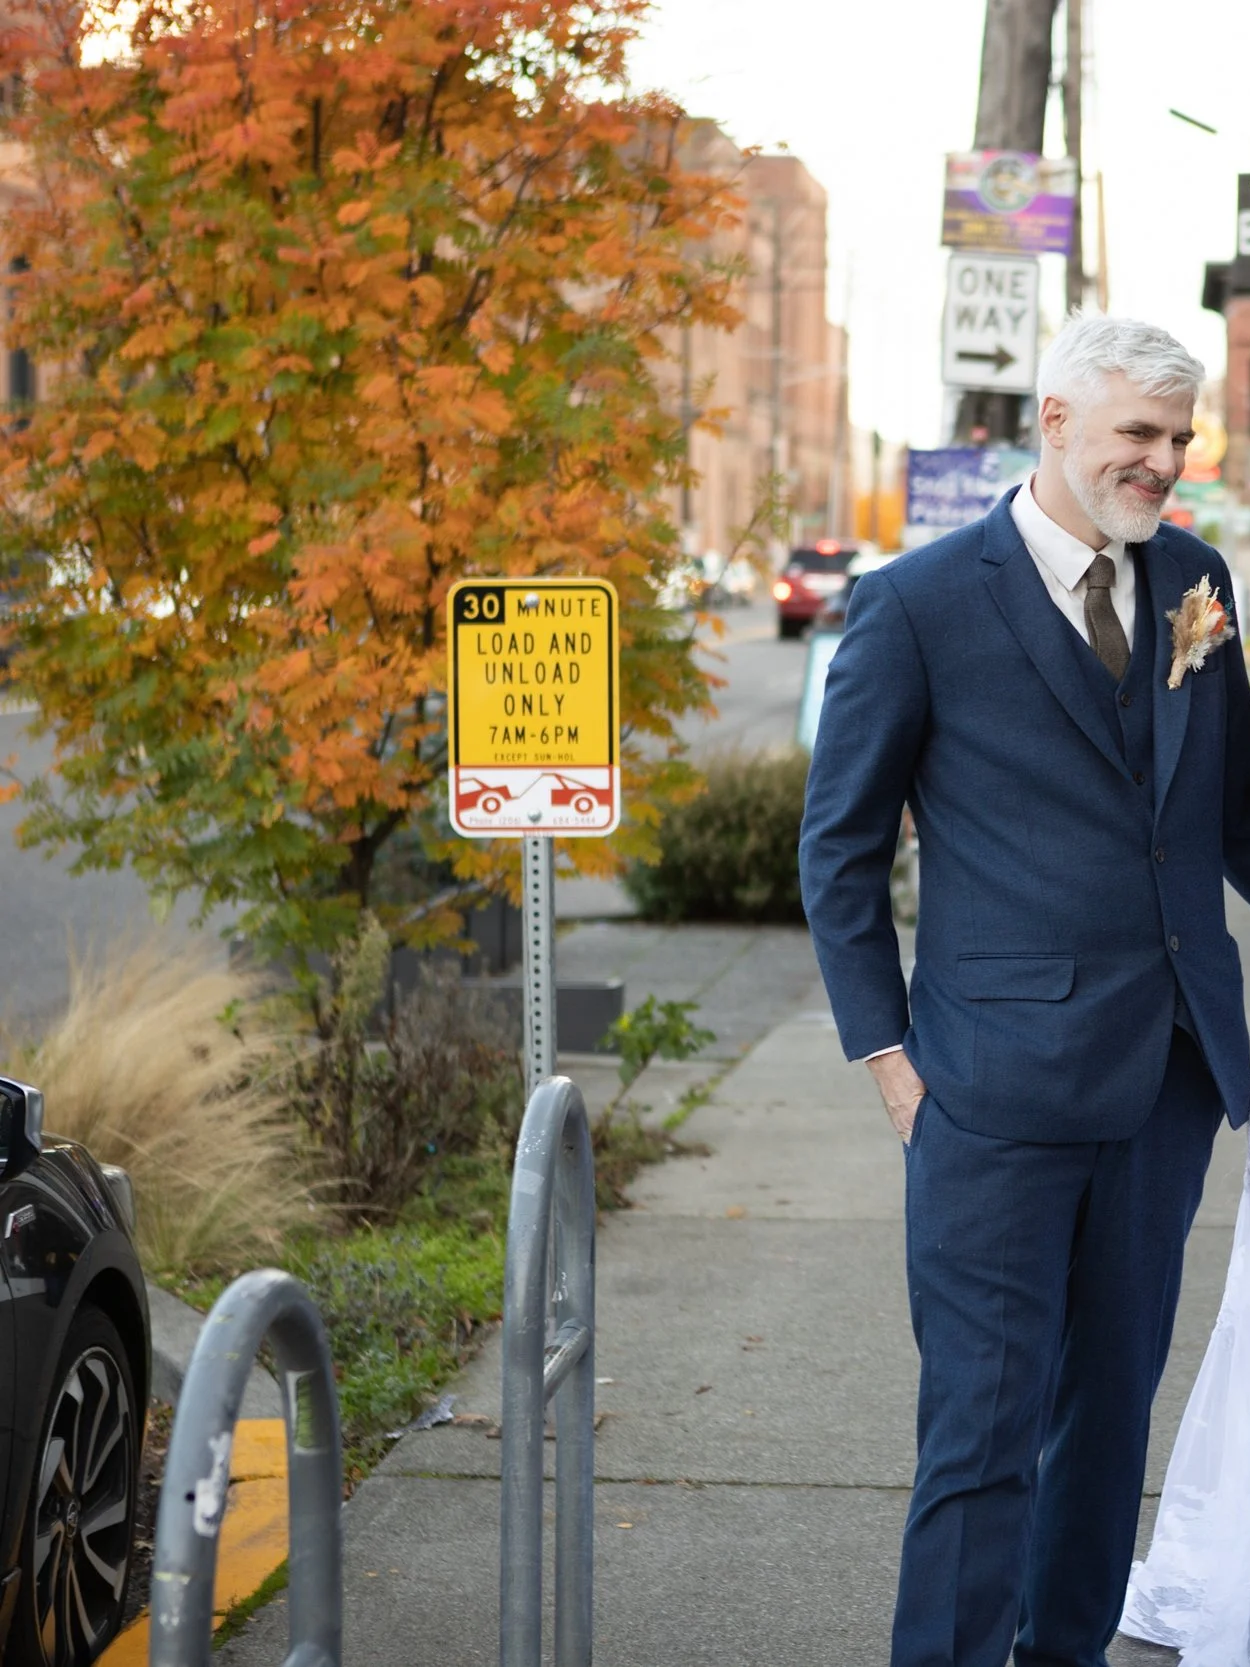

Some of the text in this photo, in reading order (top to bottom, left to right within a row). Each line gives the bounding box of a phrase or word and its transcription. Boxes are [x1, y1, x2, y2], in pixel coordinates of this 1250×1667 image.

[958, 266, 1028, 300] ONE
[953, 304, 1028, 336] WAY
[463, 592, 601, 620] 30 MINUTE
[477, 632, 593, 656] LOAD AND
[485, 661, 581, 685] UNLOAD
[504, 693, 566, 717] ONLY
[489, 726, 579, 745] 7AM-6PM
[494, 752, 528, 763] EXCEPT
